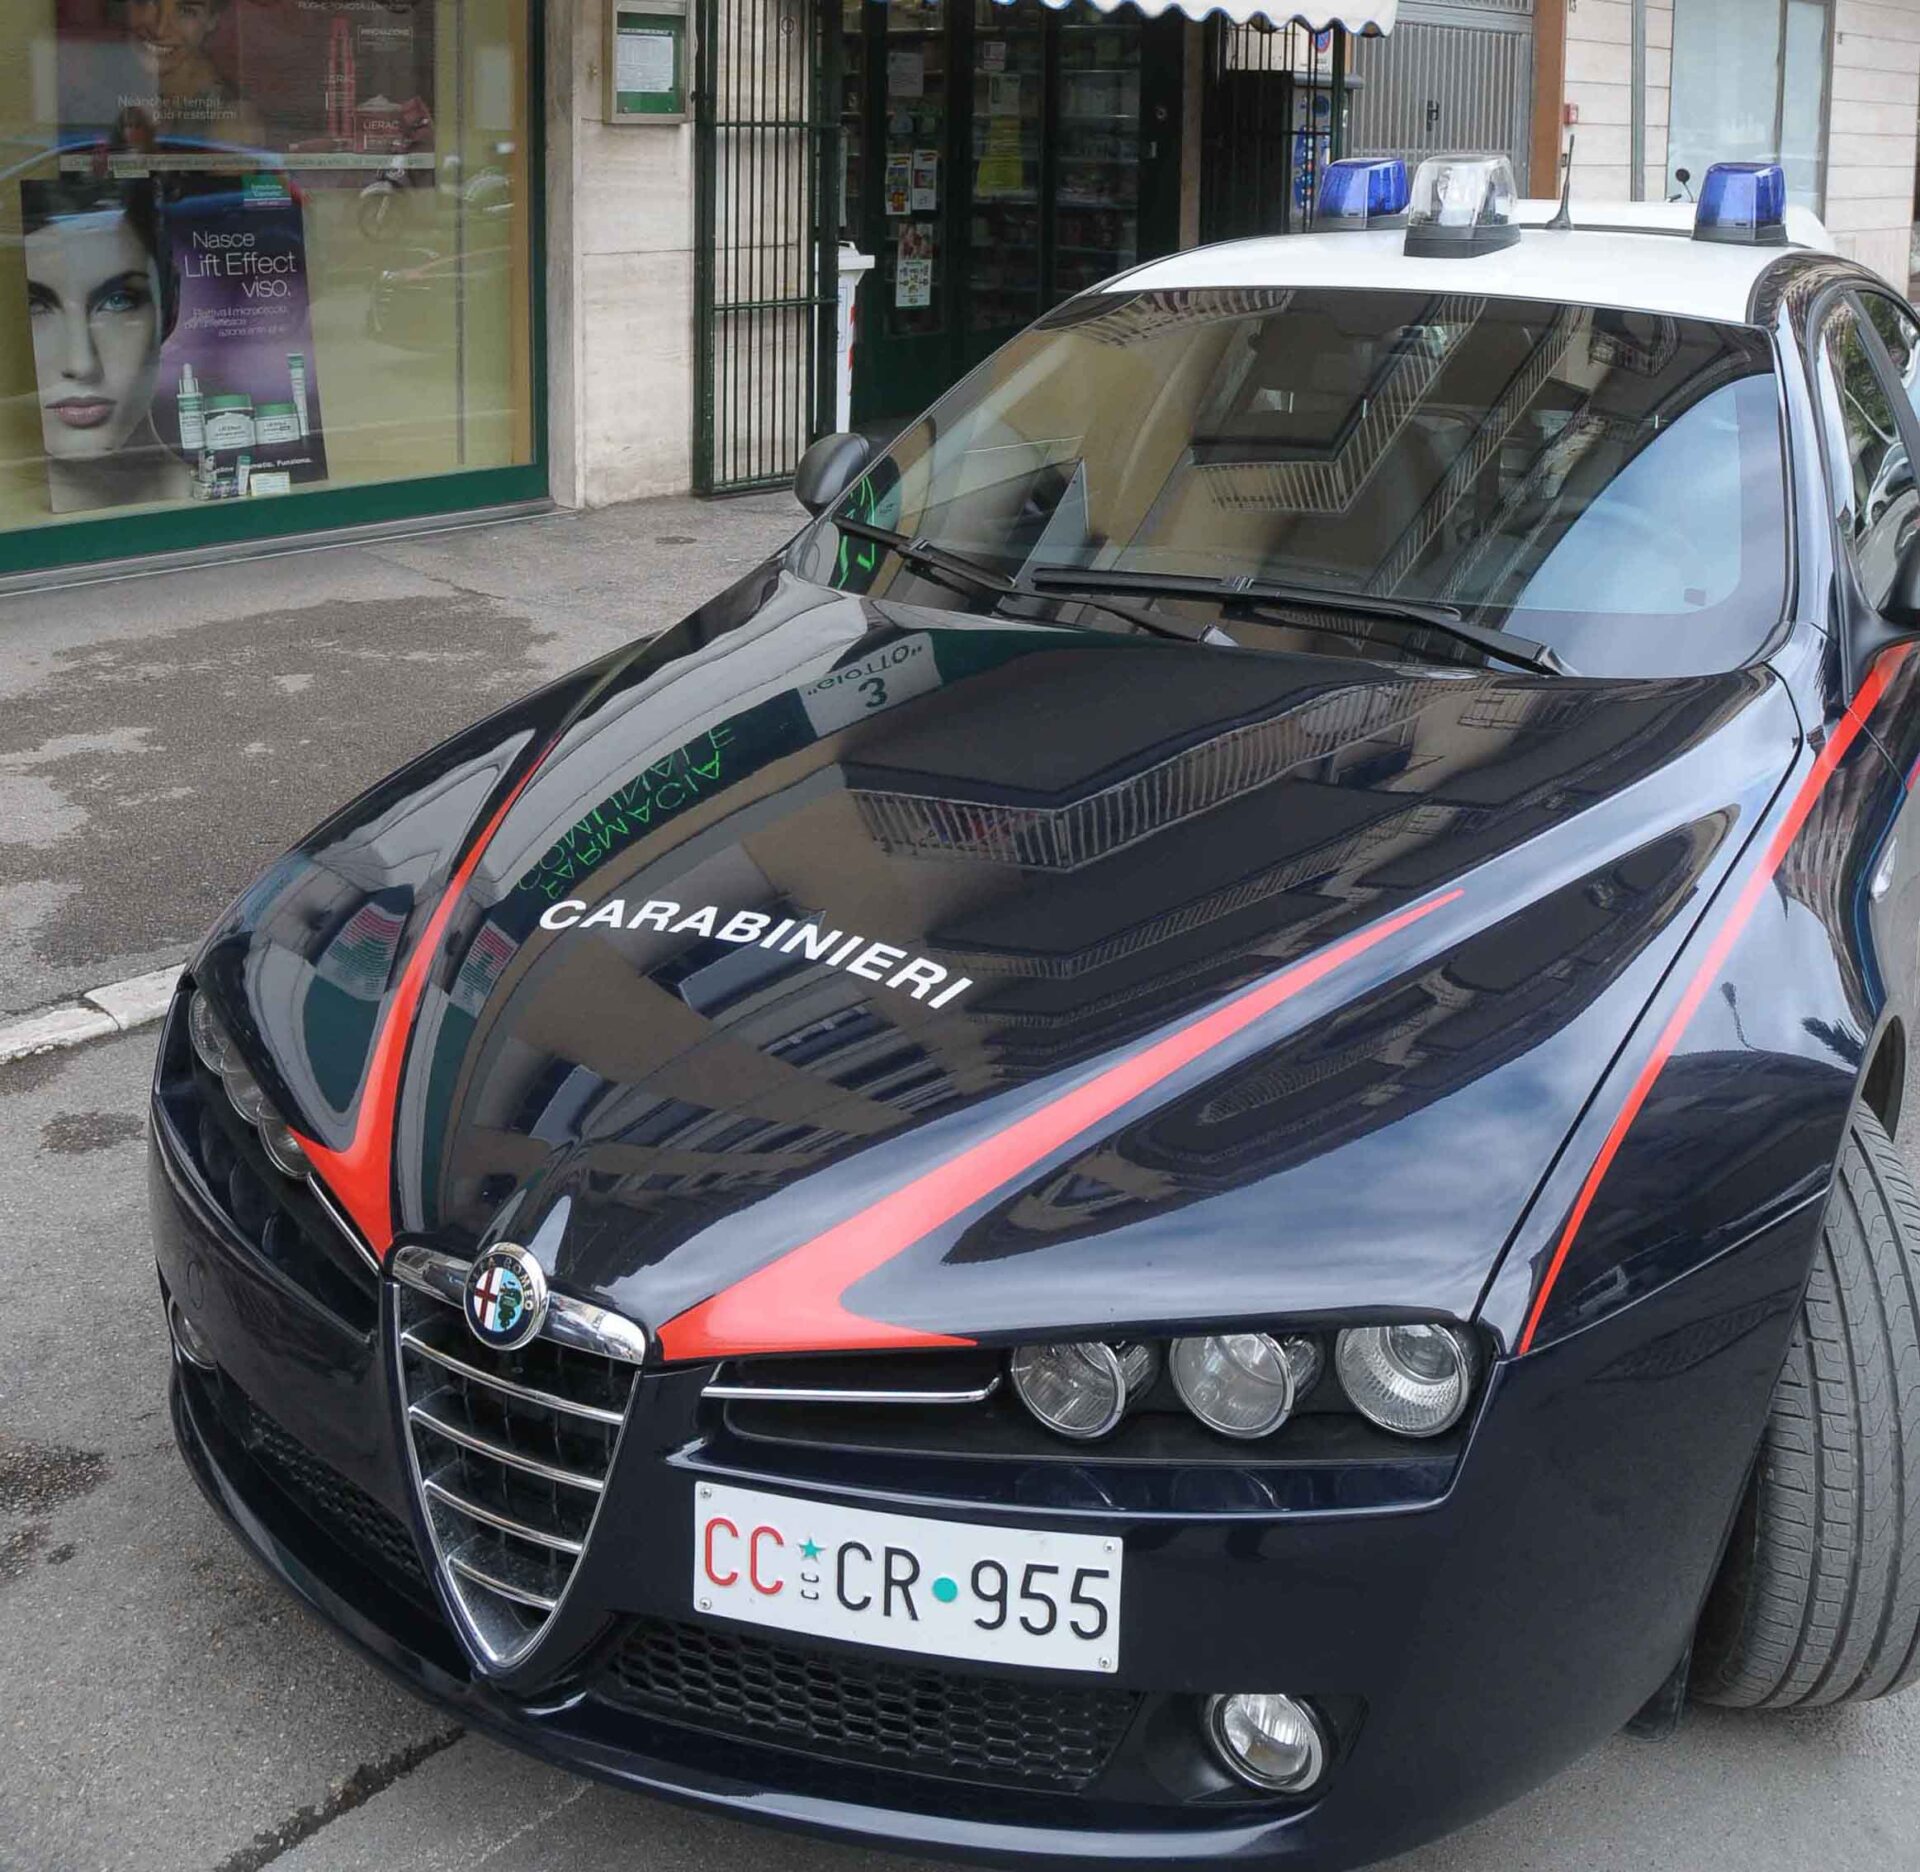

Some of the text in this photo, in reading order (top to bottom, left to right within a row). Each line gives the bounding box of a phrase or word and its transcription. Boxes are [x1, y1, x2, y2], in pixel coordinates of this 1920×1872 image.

[192, 230, 256, 249] Nasce
[184, 250, 297, 278] Lift Effect
[241, 275, 292, 298] viso.
[538, 898, 974, 1010] CARABINIERI
[704, 1517, 1110, 1641] CC CR 955
